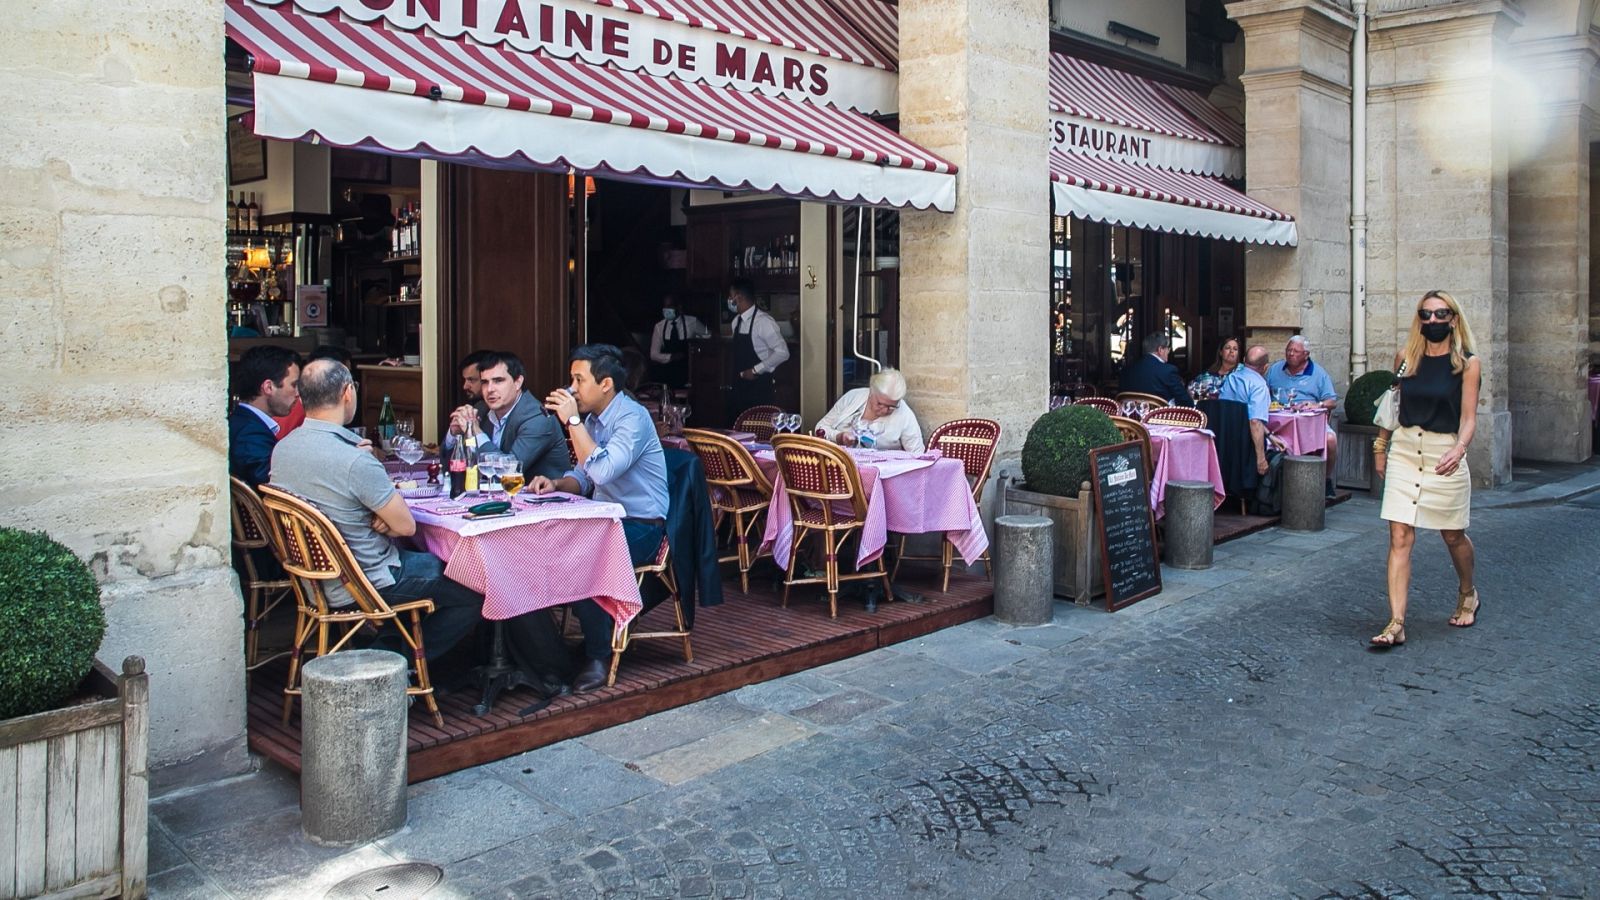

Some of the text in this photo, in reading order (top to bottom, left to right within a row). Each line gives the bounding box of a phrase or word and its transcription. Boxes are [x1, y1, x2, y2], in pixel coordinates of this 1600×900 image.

[358, 0, 829, 96] NTAINE DE MARS
[1049, 118, 1152, 159] STAURANT
